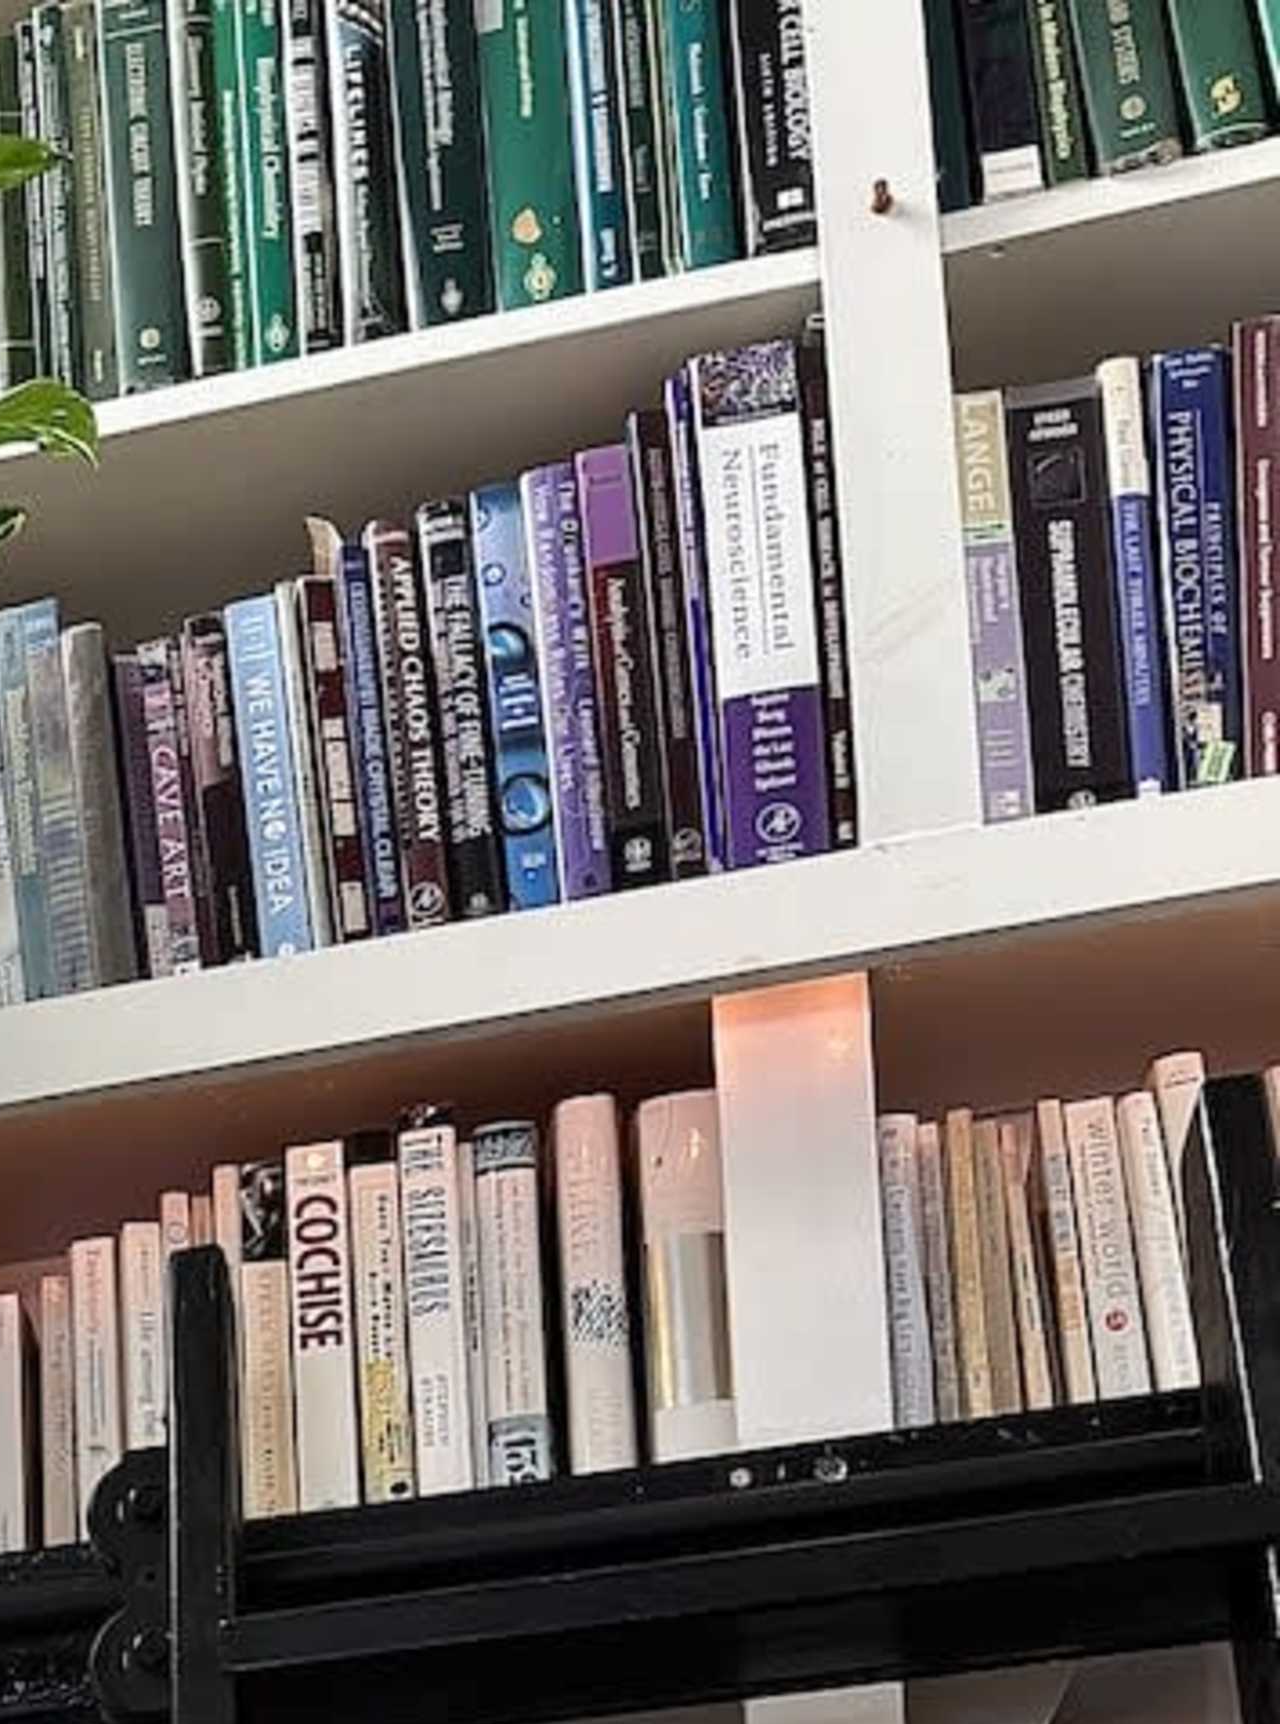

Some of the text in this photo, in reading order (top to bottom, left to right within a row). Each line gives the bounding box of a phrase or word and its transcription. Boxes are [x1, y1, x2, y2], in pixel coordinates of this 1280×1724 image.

[783, 69, 811, 162] BIOLOGY
[962, 399, 994, 512] LANGE
[1166, 411, 1201, 531] PHYSICAL
[720, 449, 752, 659] Neuroscience
[757, 442, 796, 653] Fundamental
[391, 557, 441, 841] APPLIED CHAOS THEORY
[447, 611, 476, 687] FALLACY
[1048, 520, 1090, 767] SUPRAMOLECULAR CHEMISTRY
[150, 747, 192, 898] CAVE ART
[244, 671, 294, 914] WE HAVE NO IDEA
[295, 1194, 342, 1350] COCHISE
